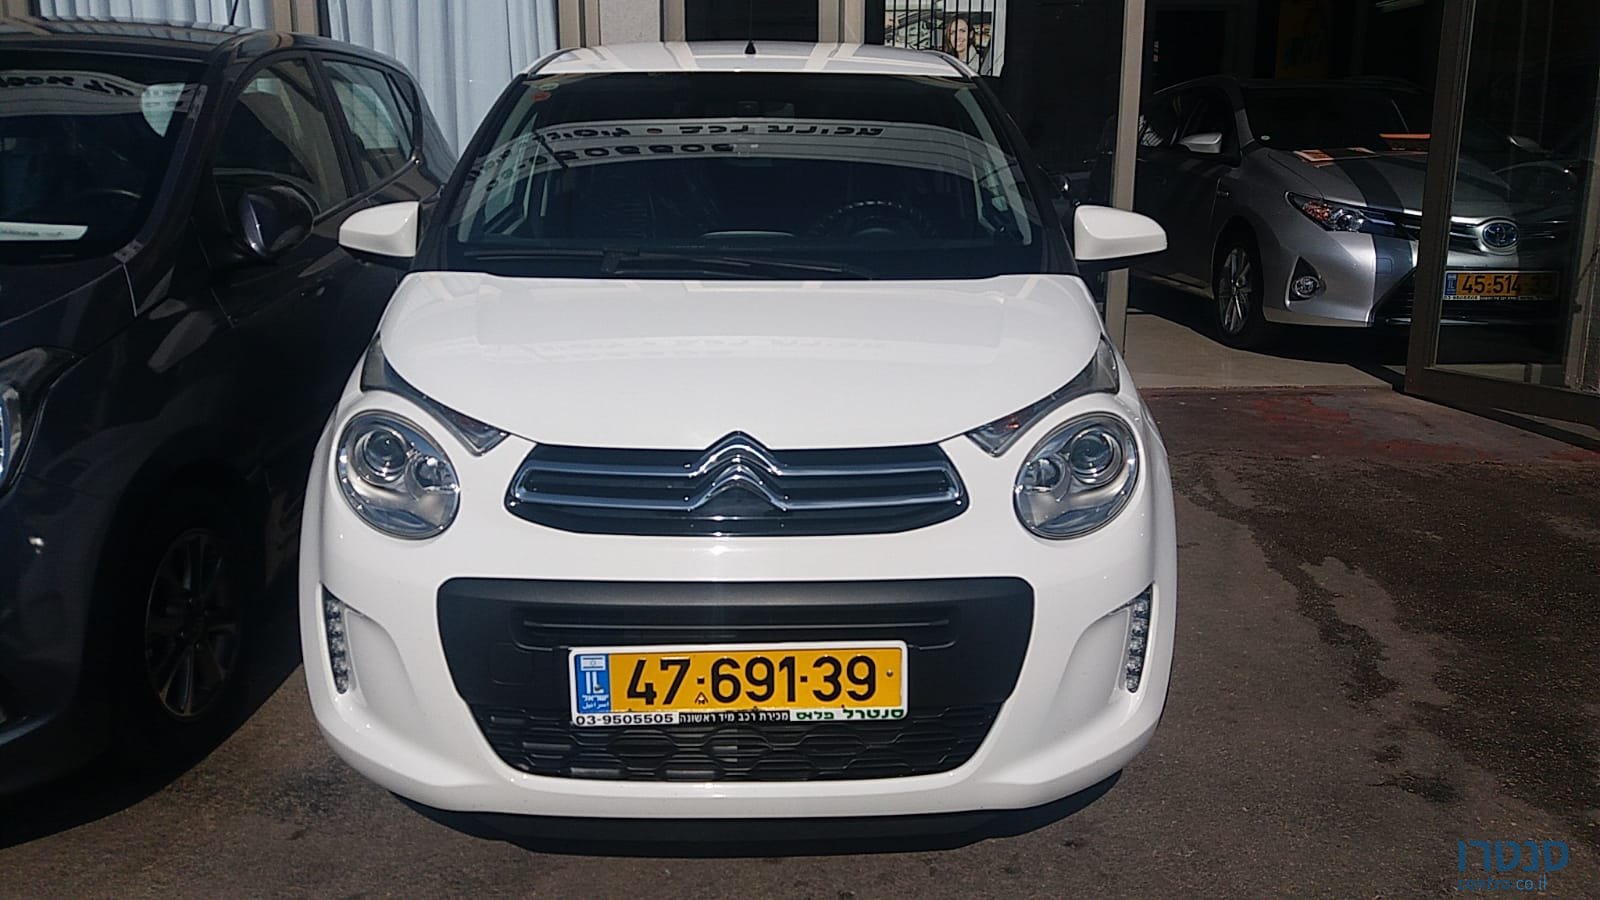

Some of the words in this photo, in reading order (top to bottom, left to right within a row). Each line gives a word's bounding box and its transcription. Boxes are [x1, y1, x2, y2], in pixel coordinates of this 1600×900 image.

[585, 671, 604, 694] IL
[679, 714, 715, 723] ראשונה
[720, 714, 734, 723] מיד
[738, 713, 756, 722] רכב
[759, 711, 789, 721] מכירת
[842, 708, 904, 719] סנטרל
[576, 713, 673, 725] 03-9505505
